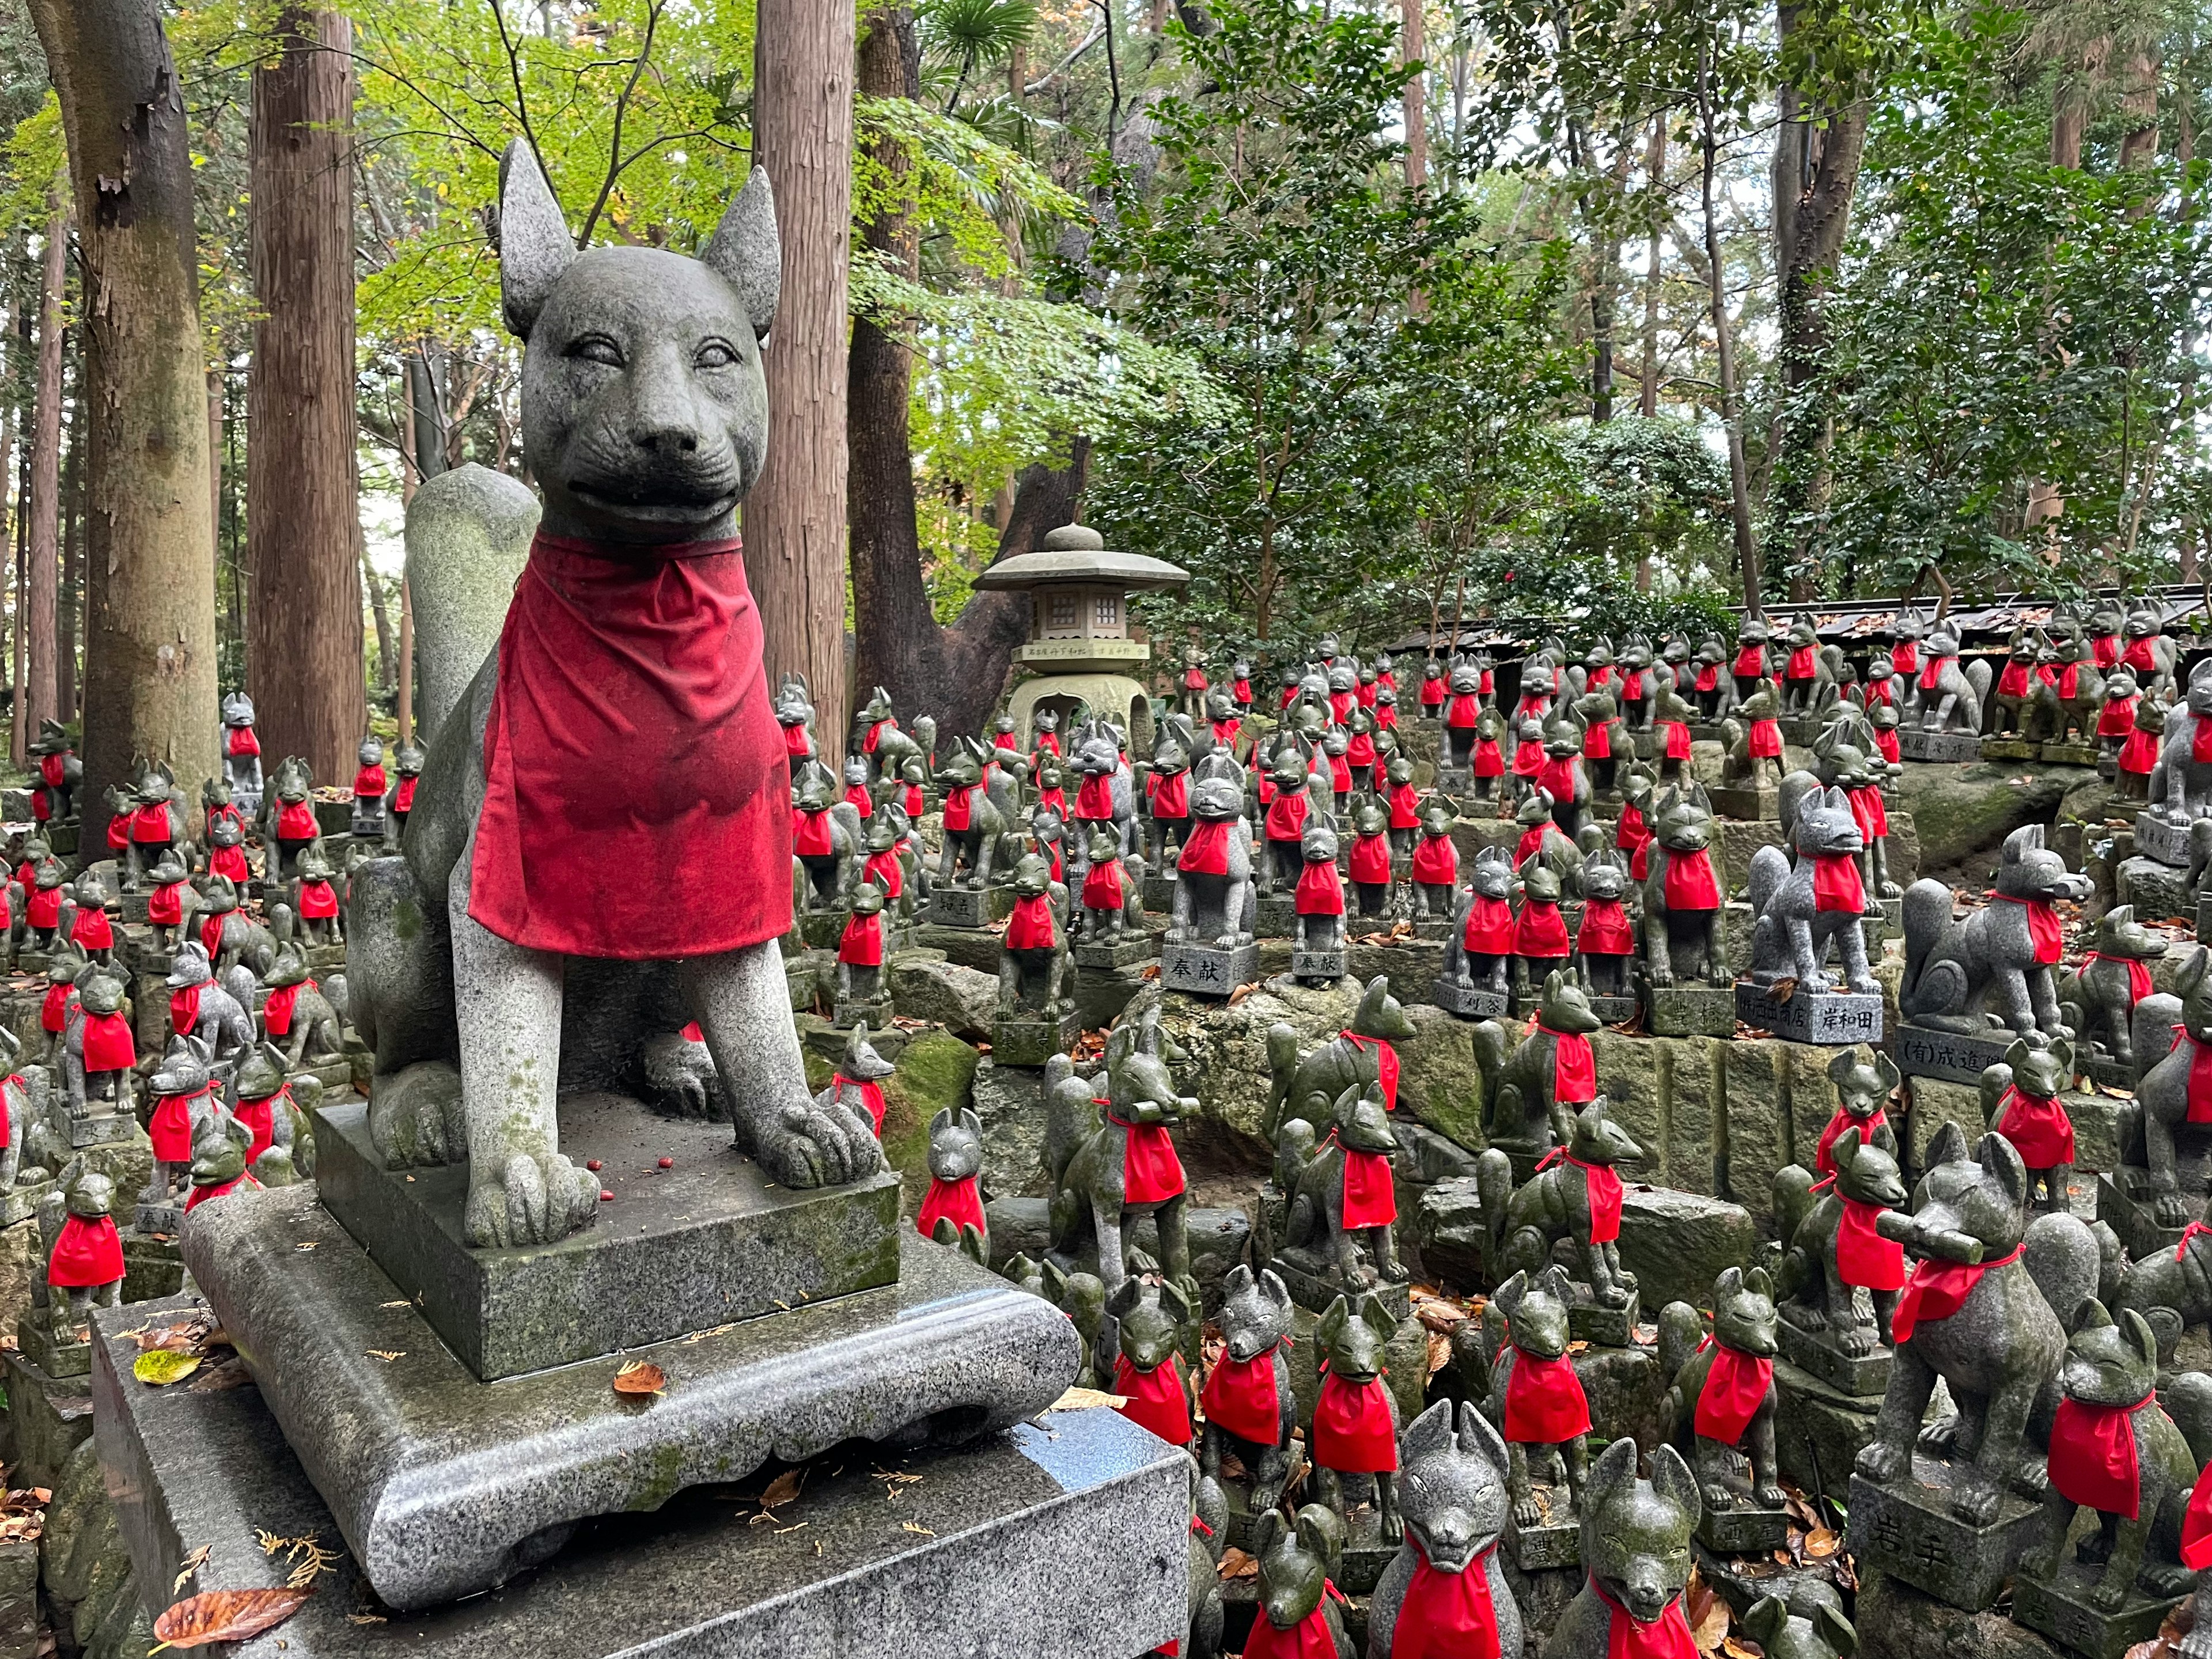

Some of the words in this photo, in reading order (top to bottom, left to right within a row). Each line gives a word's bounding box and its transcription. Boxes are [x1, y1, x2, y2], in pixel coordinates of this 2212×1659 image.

[939, 898, 971, 916] 知立
[1171, 958, 1219, 982] 奉献
[1301, 956, 1336, 972] 奉献
[1464, 998, 1501, 1014] 刈谷
[1822, 1007, 1872, 1030] 岸和田
[141, 1210, 177, 1229] 奉献
[1870, 1512, 1948, 1567] 岩手
